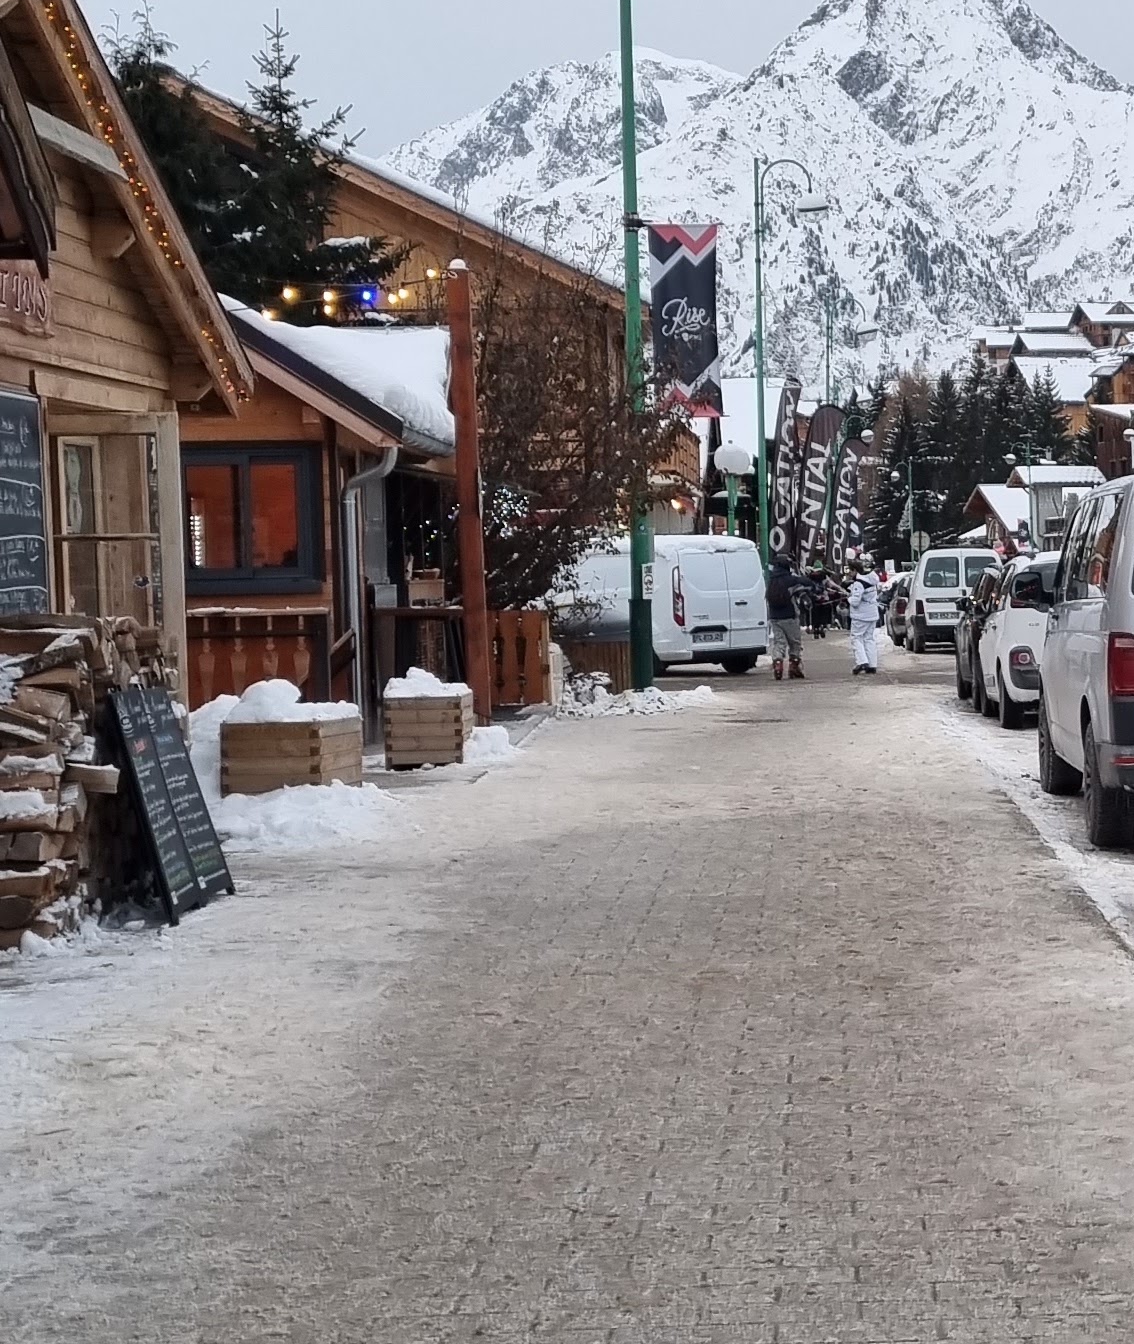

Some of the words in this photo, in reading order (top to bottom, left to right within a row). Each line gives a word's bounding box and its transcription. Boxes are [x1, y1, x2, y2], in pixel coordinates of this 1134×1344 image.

[662, 296, 711, 336] Rise
[768, 389, 796, 556] OCATION
[831, 446, 858, 568] OCATION
